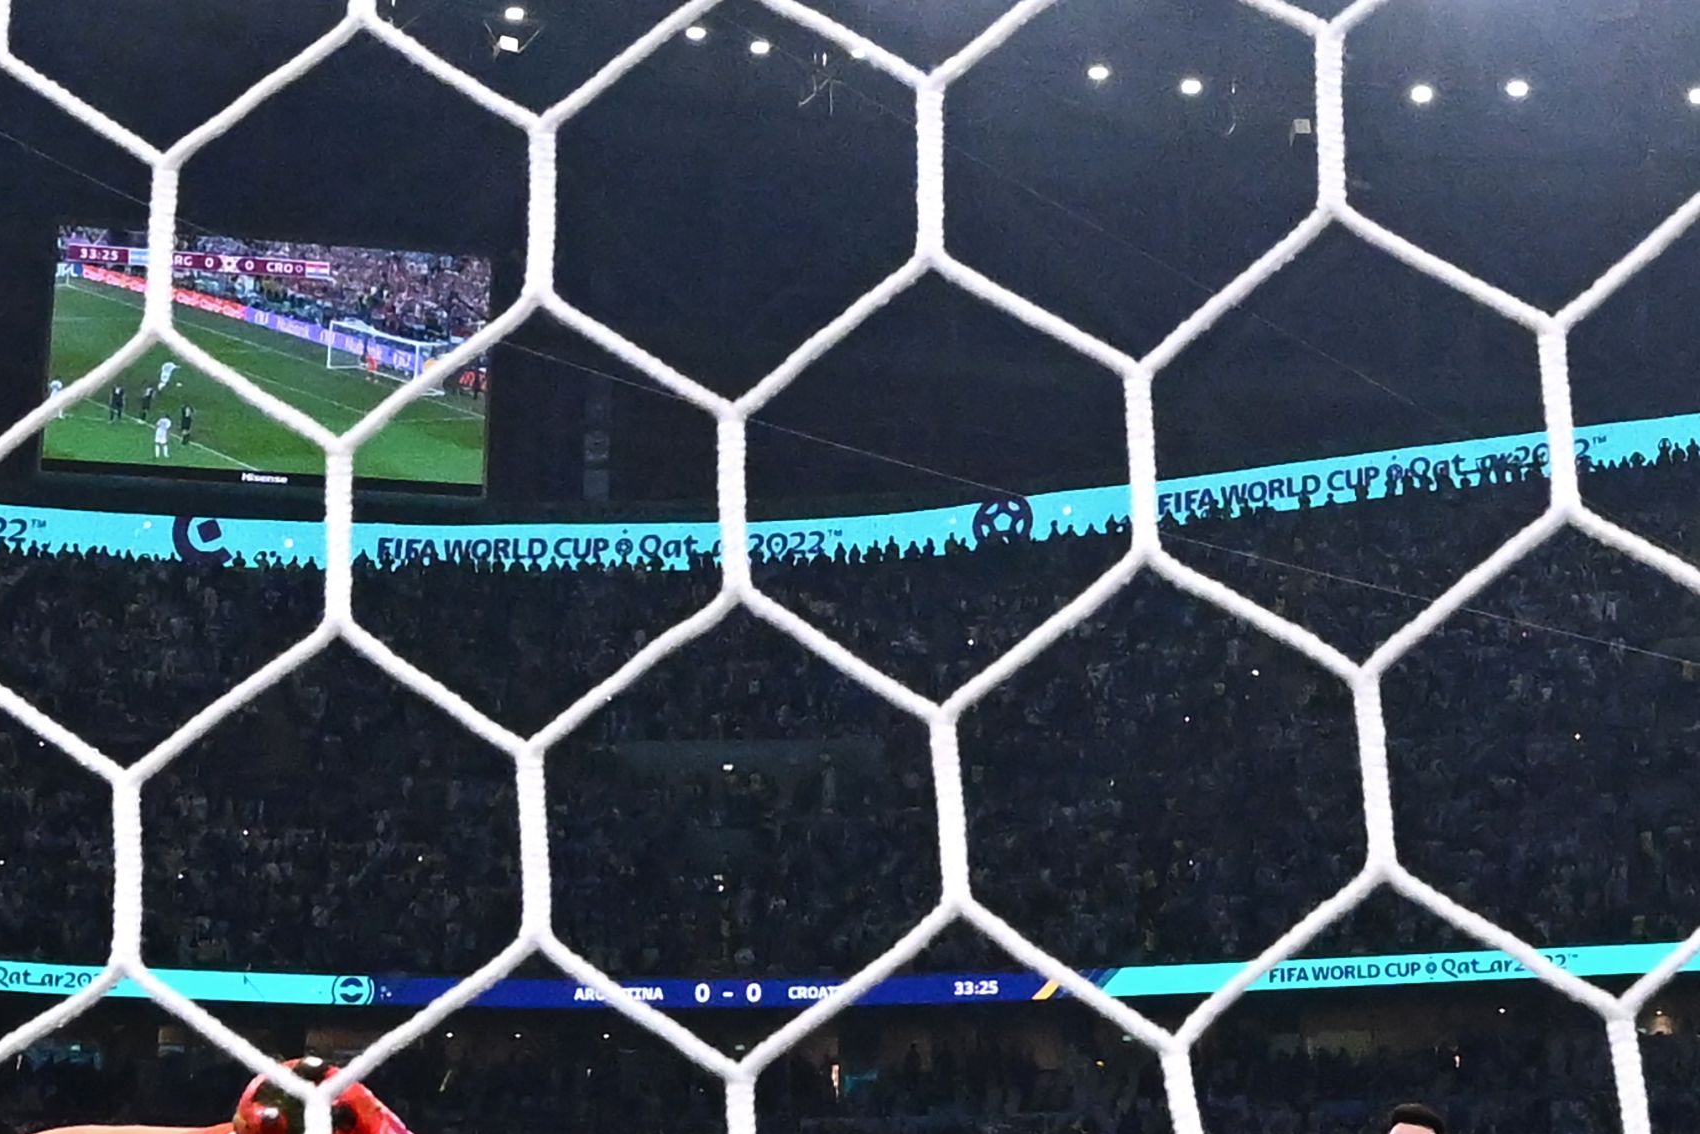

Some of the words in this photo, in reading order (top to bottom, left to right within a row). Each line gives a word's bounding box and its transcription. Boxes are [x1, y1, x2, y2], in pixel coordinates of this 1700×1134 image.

[79, 247, 119, 261] 33:25
[173, 254, 193, 267] RG
[204, 256, 214, 269] 0
[244, 259, 255, 271] 0
[265, 261, 293, 274] CRO
[1157, 487, 1217, 515] FIFA
[1220, 473, 1322, 503] WORLD
[1326, 465, 1381, 492] CUP
[376, 536, 439, 560] FIFA
[444, 537, 548, 560] WORLD
[553, 537, 609, 560] CUP
[1268, 966, 1309, 983] FIFA
[1312, 963, 1381, 981] WORLD
[1384, 961, 1421, 978] CUP
[694, 982, 711, 1003] 0
[746, 982, 762, 1003] 0
[787, 985, 841, 1000] CROAT
[953, 979, 999, 996] 33:25
